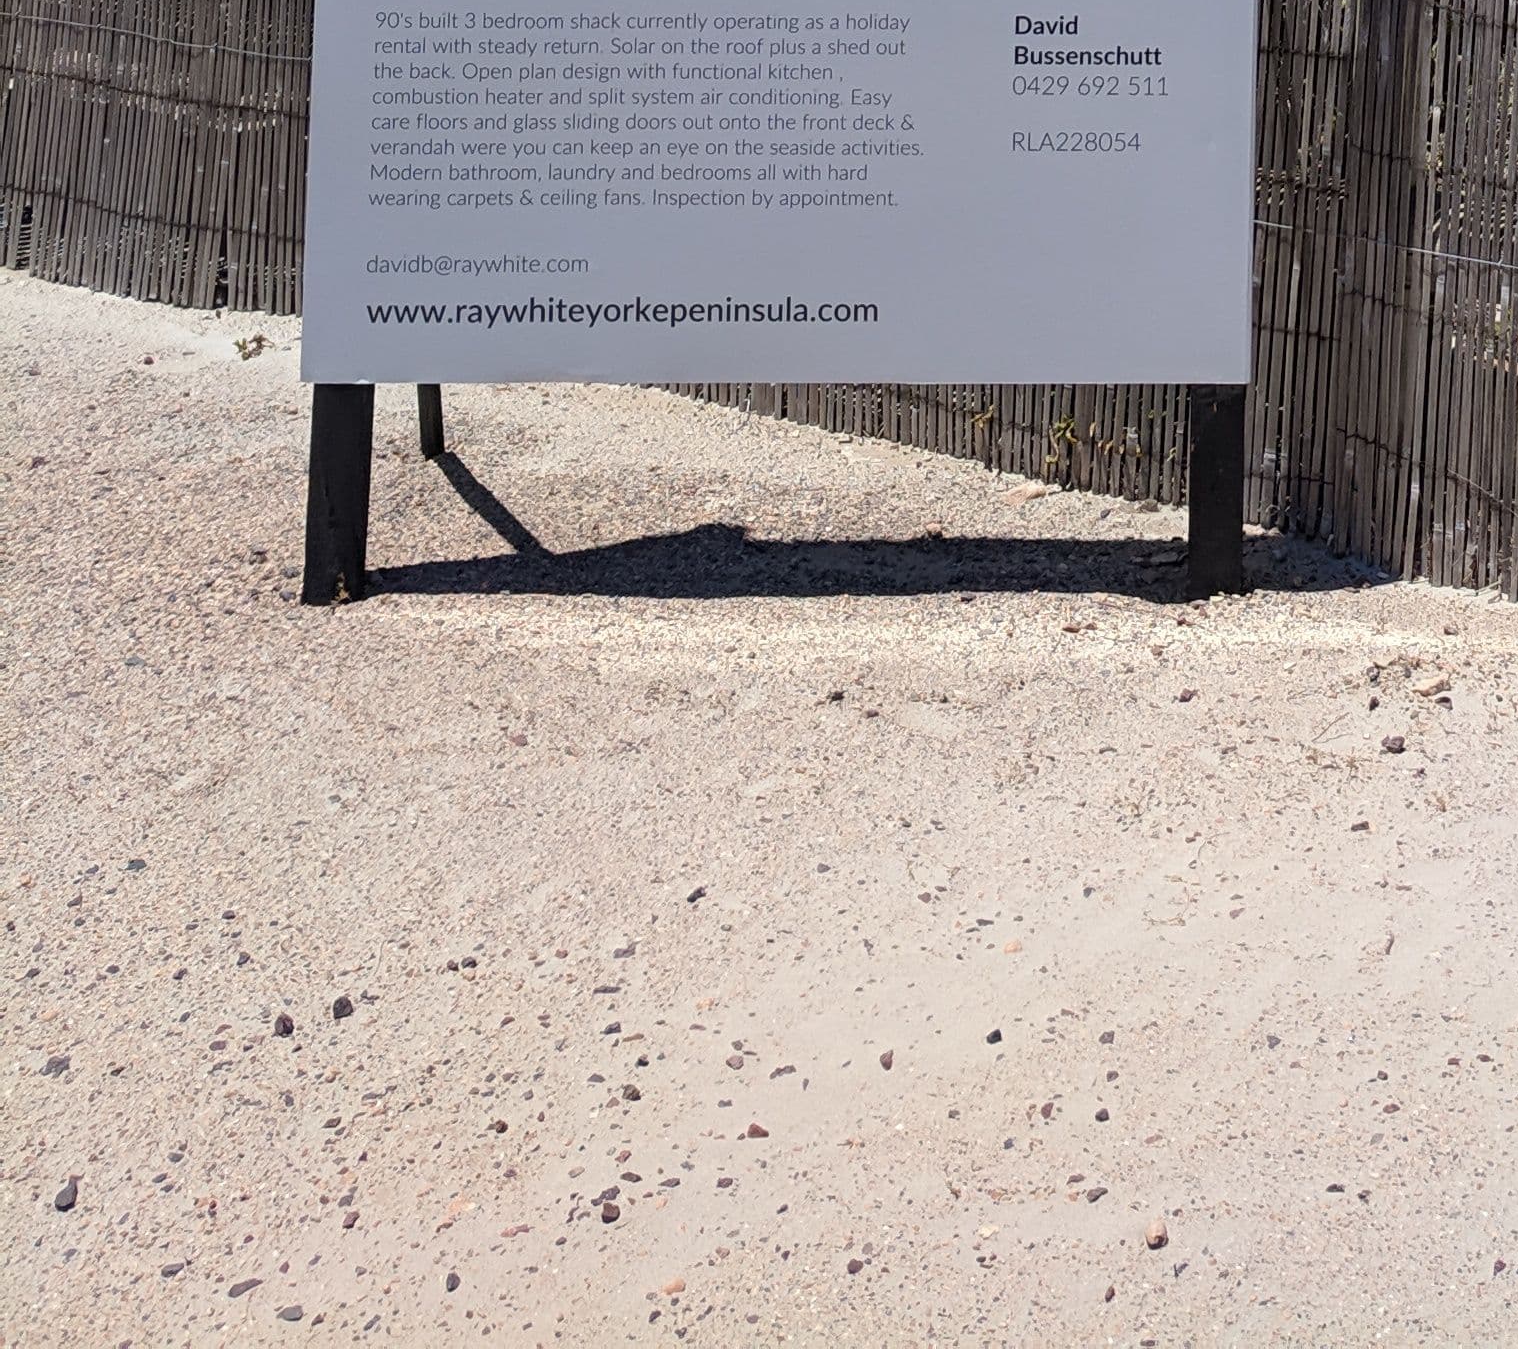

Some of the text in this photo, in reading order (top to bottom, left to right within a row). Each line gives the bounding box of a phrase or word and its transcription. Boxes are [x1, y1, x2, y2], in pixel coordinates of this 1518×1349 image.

[375, 11, 911, 34] 90's built 3 bedroom shack currently operating as a holiday
[1014, 14, 1079, 36] David
[374, 36, 426, 54] rental
[432, 36, 472, 55] with
[478, 37, 538, 58] steady
[610, 36, 656, 55] Solar
[661, 41, 684, 55] on
[690, 37, 720, 55] the
[726, 37, 764, 55] roof
[769, 37, 806, 59] plus
[811, 42, 822, 55] a
[827, 38, 870, 56] shed
[875, 39, 906, 56] out
[1013, 44, 1163, 66] Bussenschutt
[373, 61, 405, 80] the
[409, 61, 456, 80] back.
[462, 62, 513, 83] Open
[518, 61, 556, 85] plan
[562, 62, 621, 85] design
[626, 62, 666, 80] with
[672, 62, 762, 80] functional
[768, 62, 833, 81] kitchen
[1012, 75, 1169, 97] 0429 692 511
[371, 87, 479, 109] combustion
[485, 87, 544, 106] heater
[548, 86, 583, 106] and
[588, 87, 626, 109] split
[631, 88, 694, 108] system
[700, 87, 724, 105] air
[851, 88, 893, 109] Easy
[371, 112, 915, 134] care floors and glass sliding doors out onto the front deck &
[370, 137, 924, 159] verandah were you can keep an eye on the seaside activities.
[1012, 131, 1142, 153] RLA228054
[370, 162, 868, 183] Modern bathroom, laundry and bedrooms all with hard
[368, 188, 899, 210] wearing carpets & ceiling fans. Inspection by appointment.
[366, 254, 589, 277] davidb@raywhite.com
[366, 295, 879, 330] www.raywhiteyorkepeninsula.com
